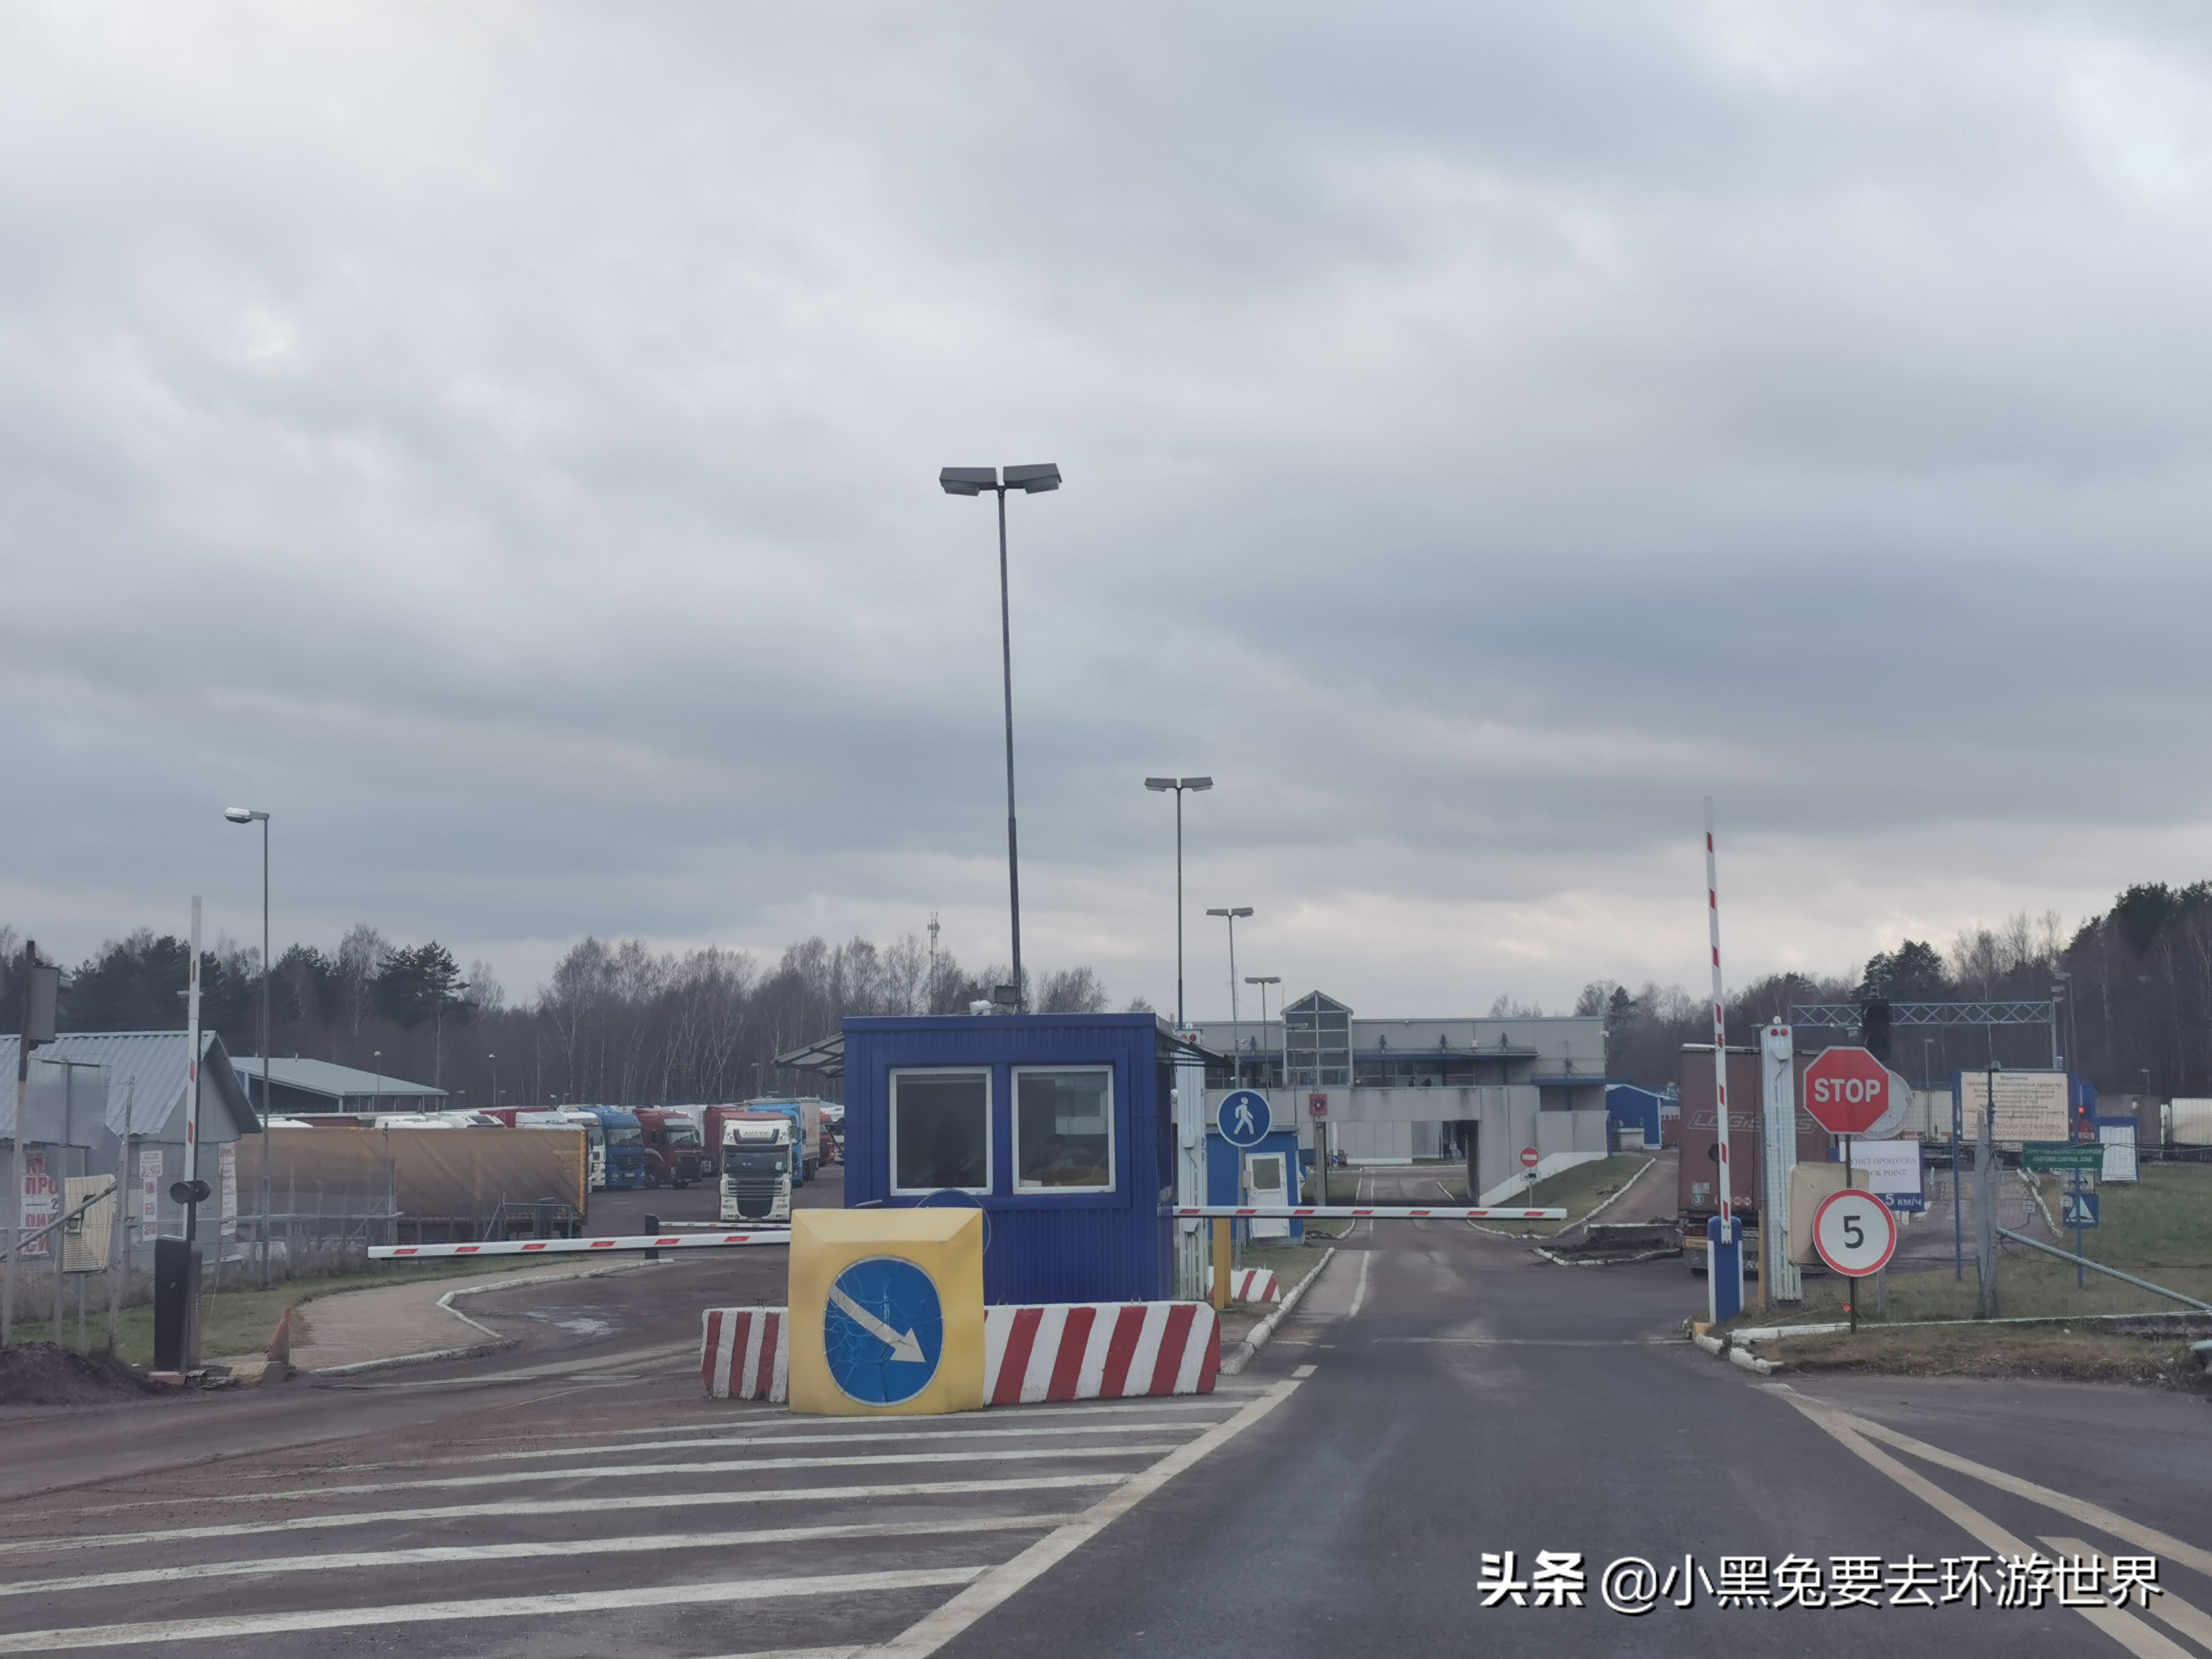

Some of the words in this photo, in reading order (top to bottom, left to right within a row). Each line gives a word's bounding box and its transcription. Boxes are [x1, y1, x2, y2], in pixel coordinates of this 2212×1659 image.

[1814, 1078, 1881, 1103] STOP
[1885, 1193, 1894, 1205] 5
[1843, 1215, 1865, 1249] 5
